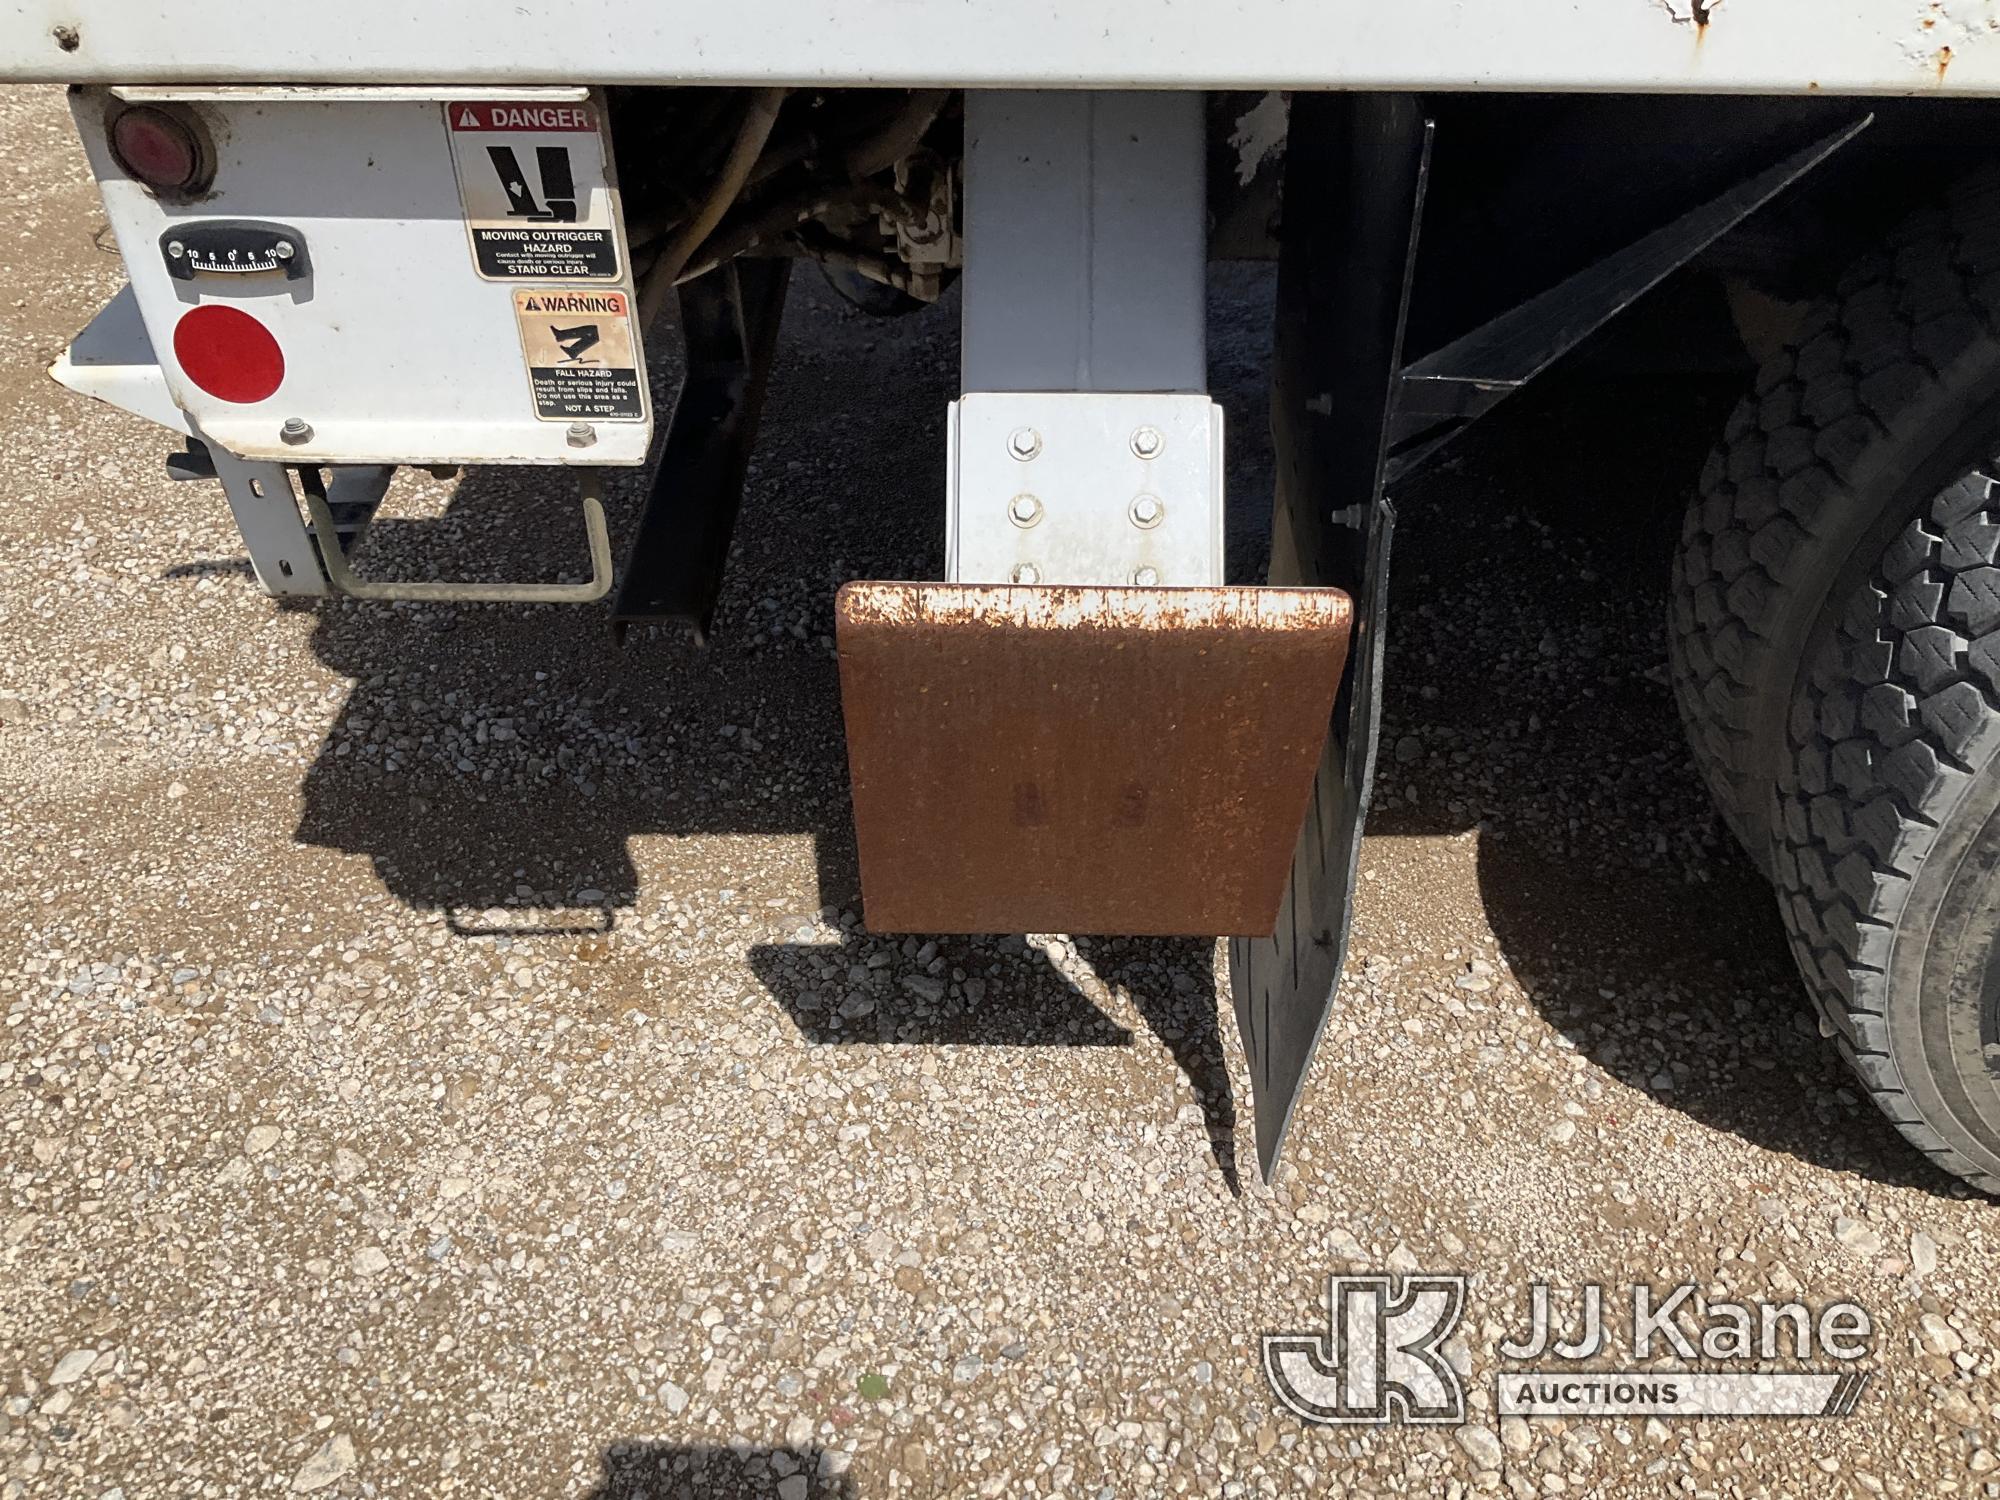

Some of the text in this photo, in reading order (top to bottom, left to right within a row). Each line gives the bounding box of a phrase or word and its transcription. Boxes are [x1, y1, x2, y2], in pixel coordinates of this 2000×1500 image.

[491, 108, 588, 127] DANGER
[482, 232, 603, 241] MOVING OUTRIGGER
[524, 244, 572, 252] HAZARD
[187, 250, 198, 258] 10
[209, 252, 215, 260] 5
[248, 252, 255, 260] 5
[265, 249, 276, 258] 10
[508, 266, 588, 274] STAND CLEAR
[541, 297, 620, 312] WARNING
